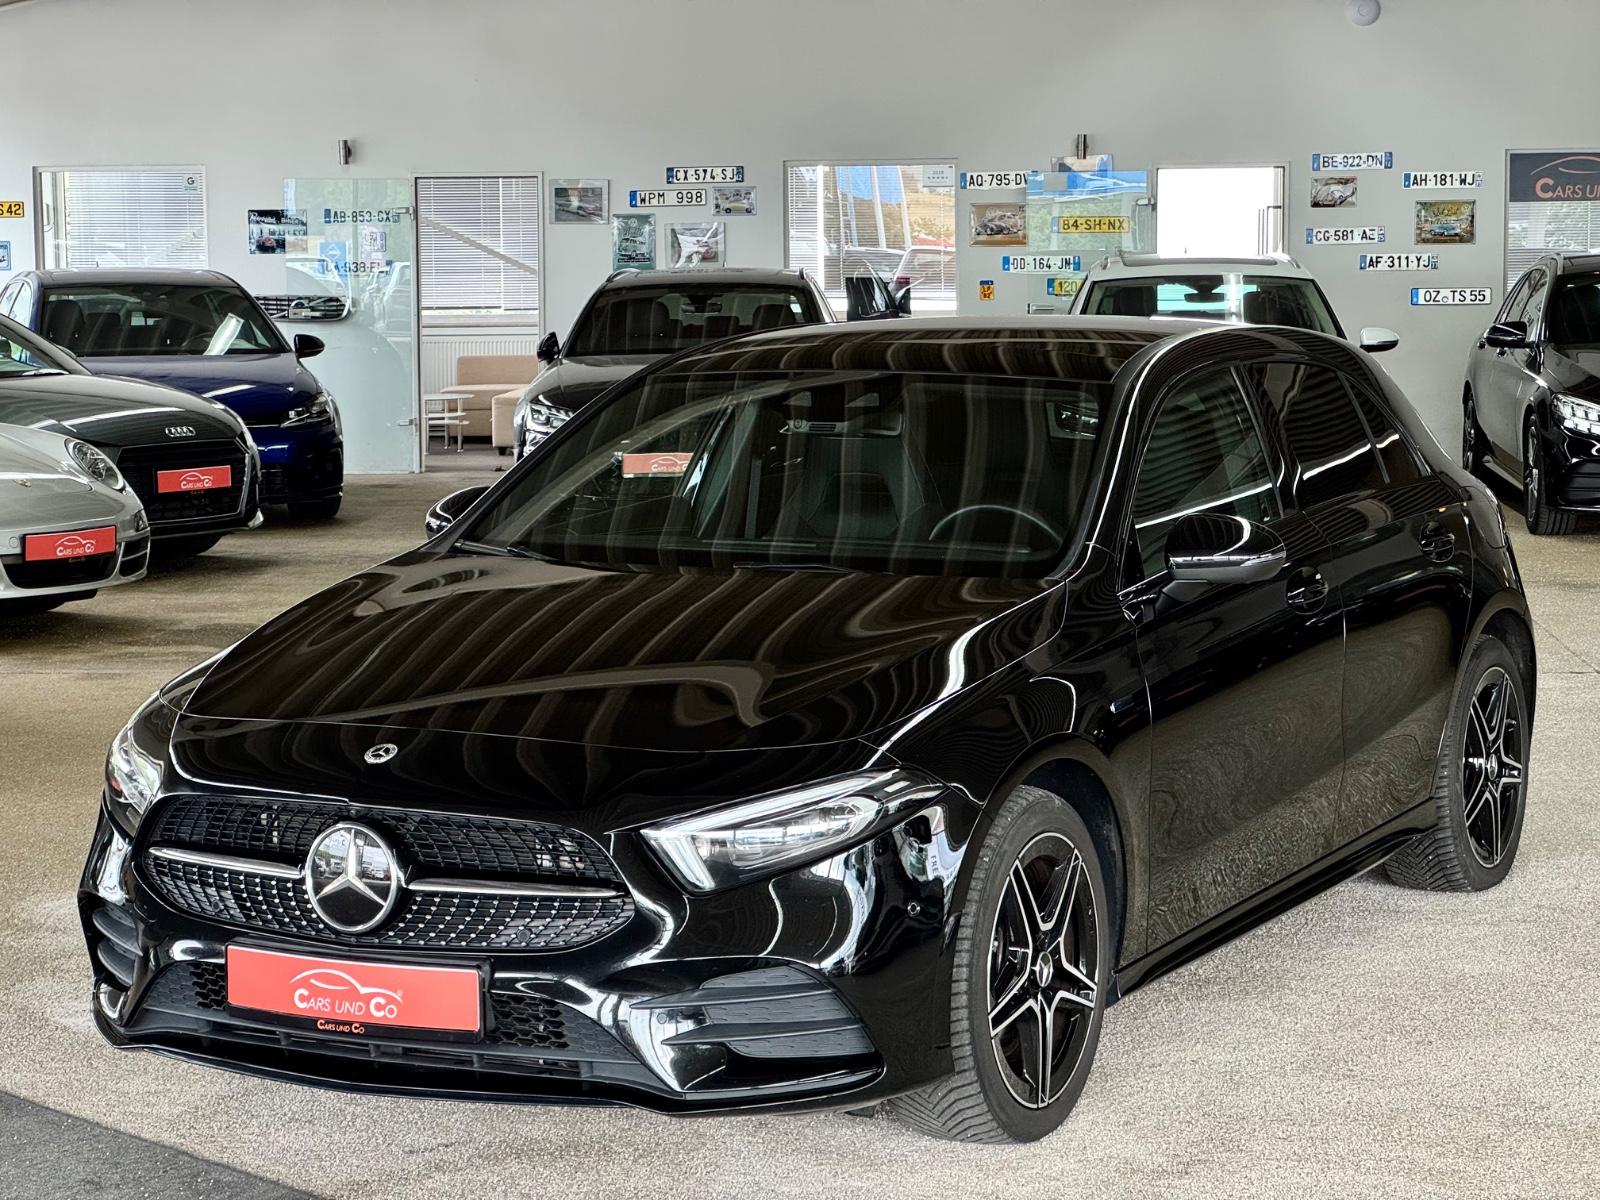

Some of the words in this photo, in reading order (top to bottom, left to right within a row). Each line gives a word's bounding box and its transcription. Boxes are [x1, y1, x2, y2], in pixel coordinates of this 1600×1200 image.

[1322, 154, 1384, 169] BE-922-DN
[674, 167, 736, 181] CX-574-SJ
[1411, 173, 1476, 187] AH-181-WJ
[639, 193, 665, 205] WPM
[676, 191, 704, 204] 998
[1367, 255, 1431, 269] AF-311-YJ
[335, 1000, 366, 1016] UND
